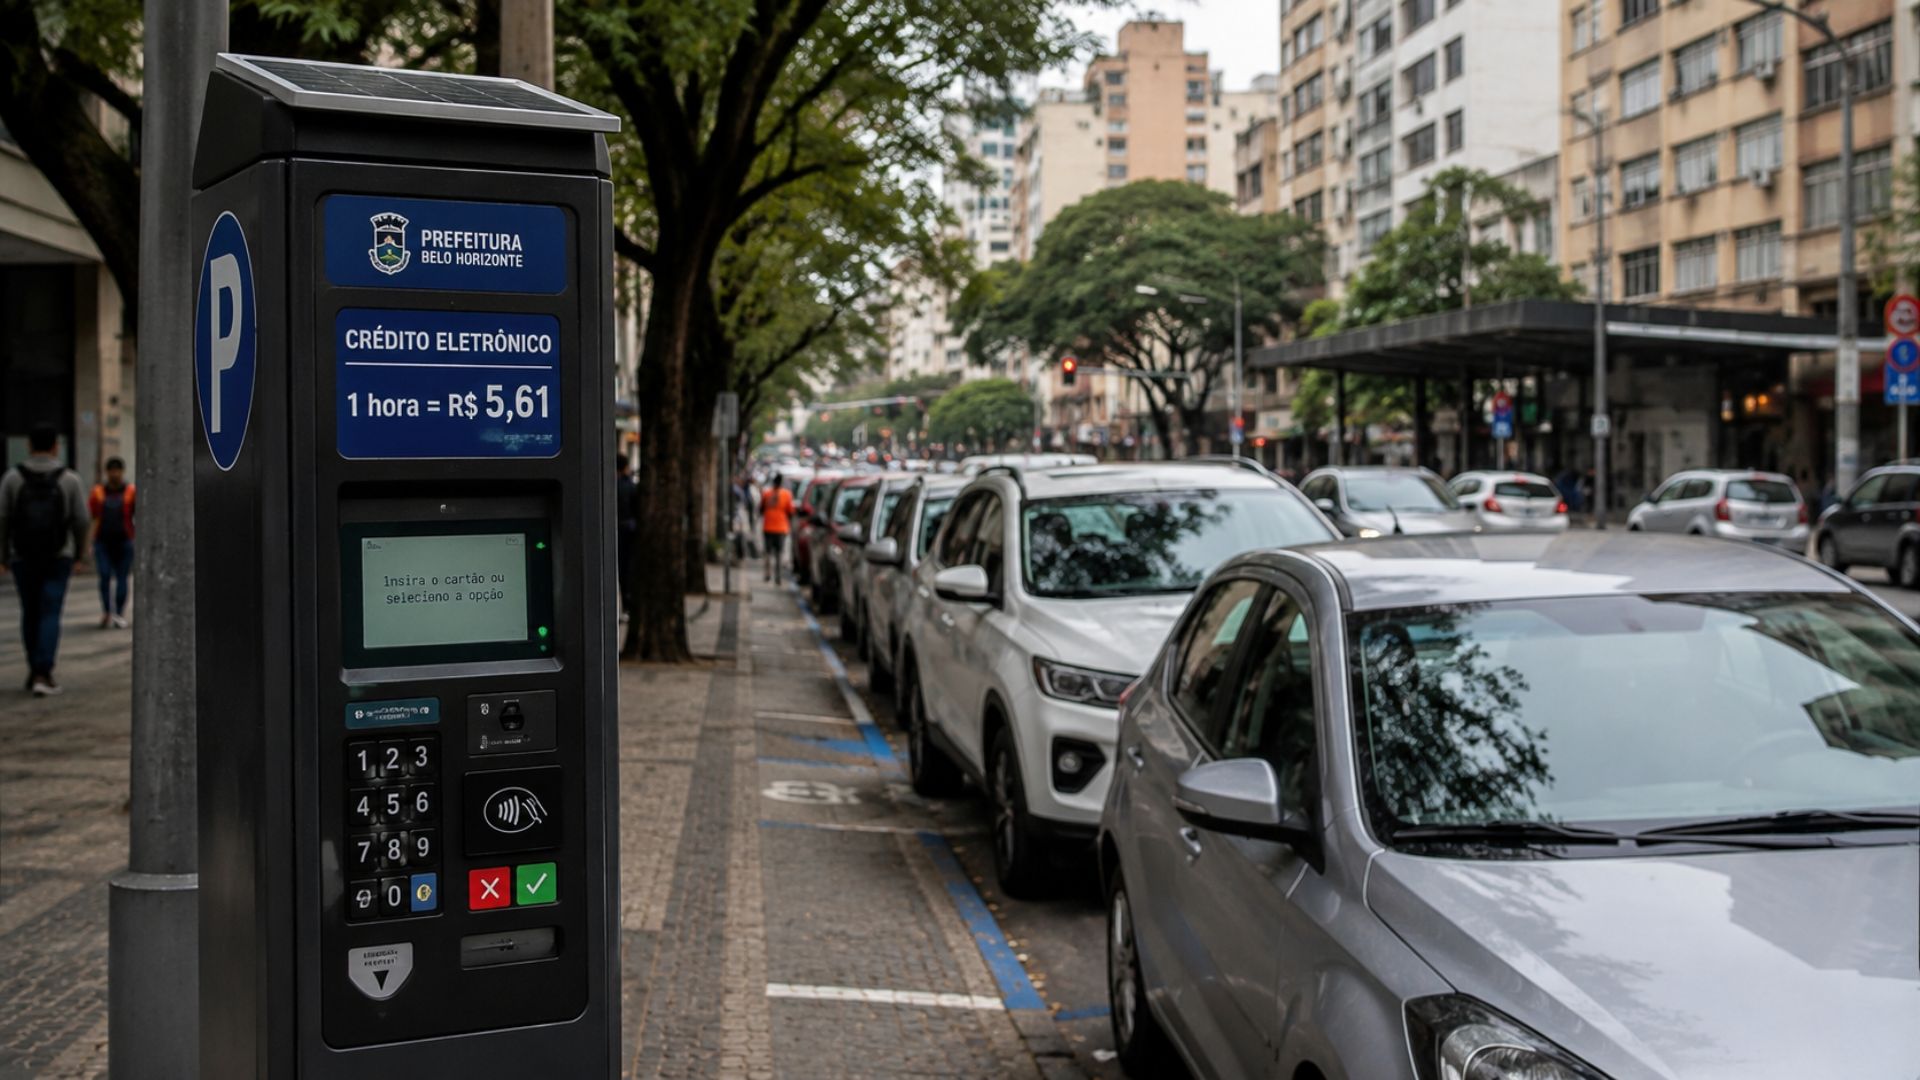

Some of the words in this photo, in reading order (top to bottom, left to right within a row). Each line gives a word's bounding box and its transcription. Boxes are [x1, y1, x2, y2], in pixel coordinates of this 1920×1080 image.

[420, 229, 523, 252] PREFEITURA
[421, 250, 452, 265] BELO
[210, 252, 243, 434] P
[345, 325, 430, 352] CRÉDITO
[436, 328, 552, 355] ELETRÔNICO
[347, 393, 358, 417] 1
[368, 392, 420, 417] hora
[448, 392, 479, 420] R$
[485, 384, 550, 424] 5,61
[431, 576, 439, 586] o
[490, 573, 505, 583] ou
[455, 592, 463, 601] a
[357, 750, 367, 771] 1
[386, 747, 399, 769] 2
[415, 745, 428, 767] 3
[356, 795, 370, 817] 4
[387, 793, 400, 815] 5
[416, 791, 429, 813] 6
[357, 841, 371, 863] 7
[387, 838, 401, 860] 8
[417, 837, 430, 857] 9
